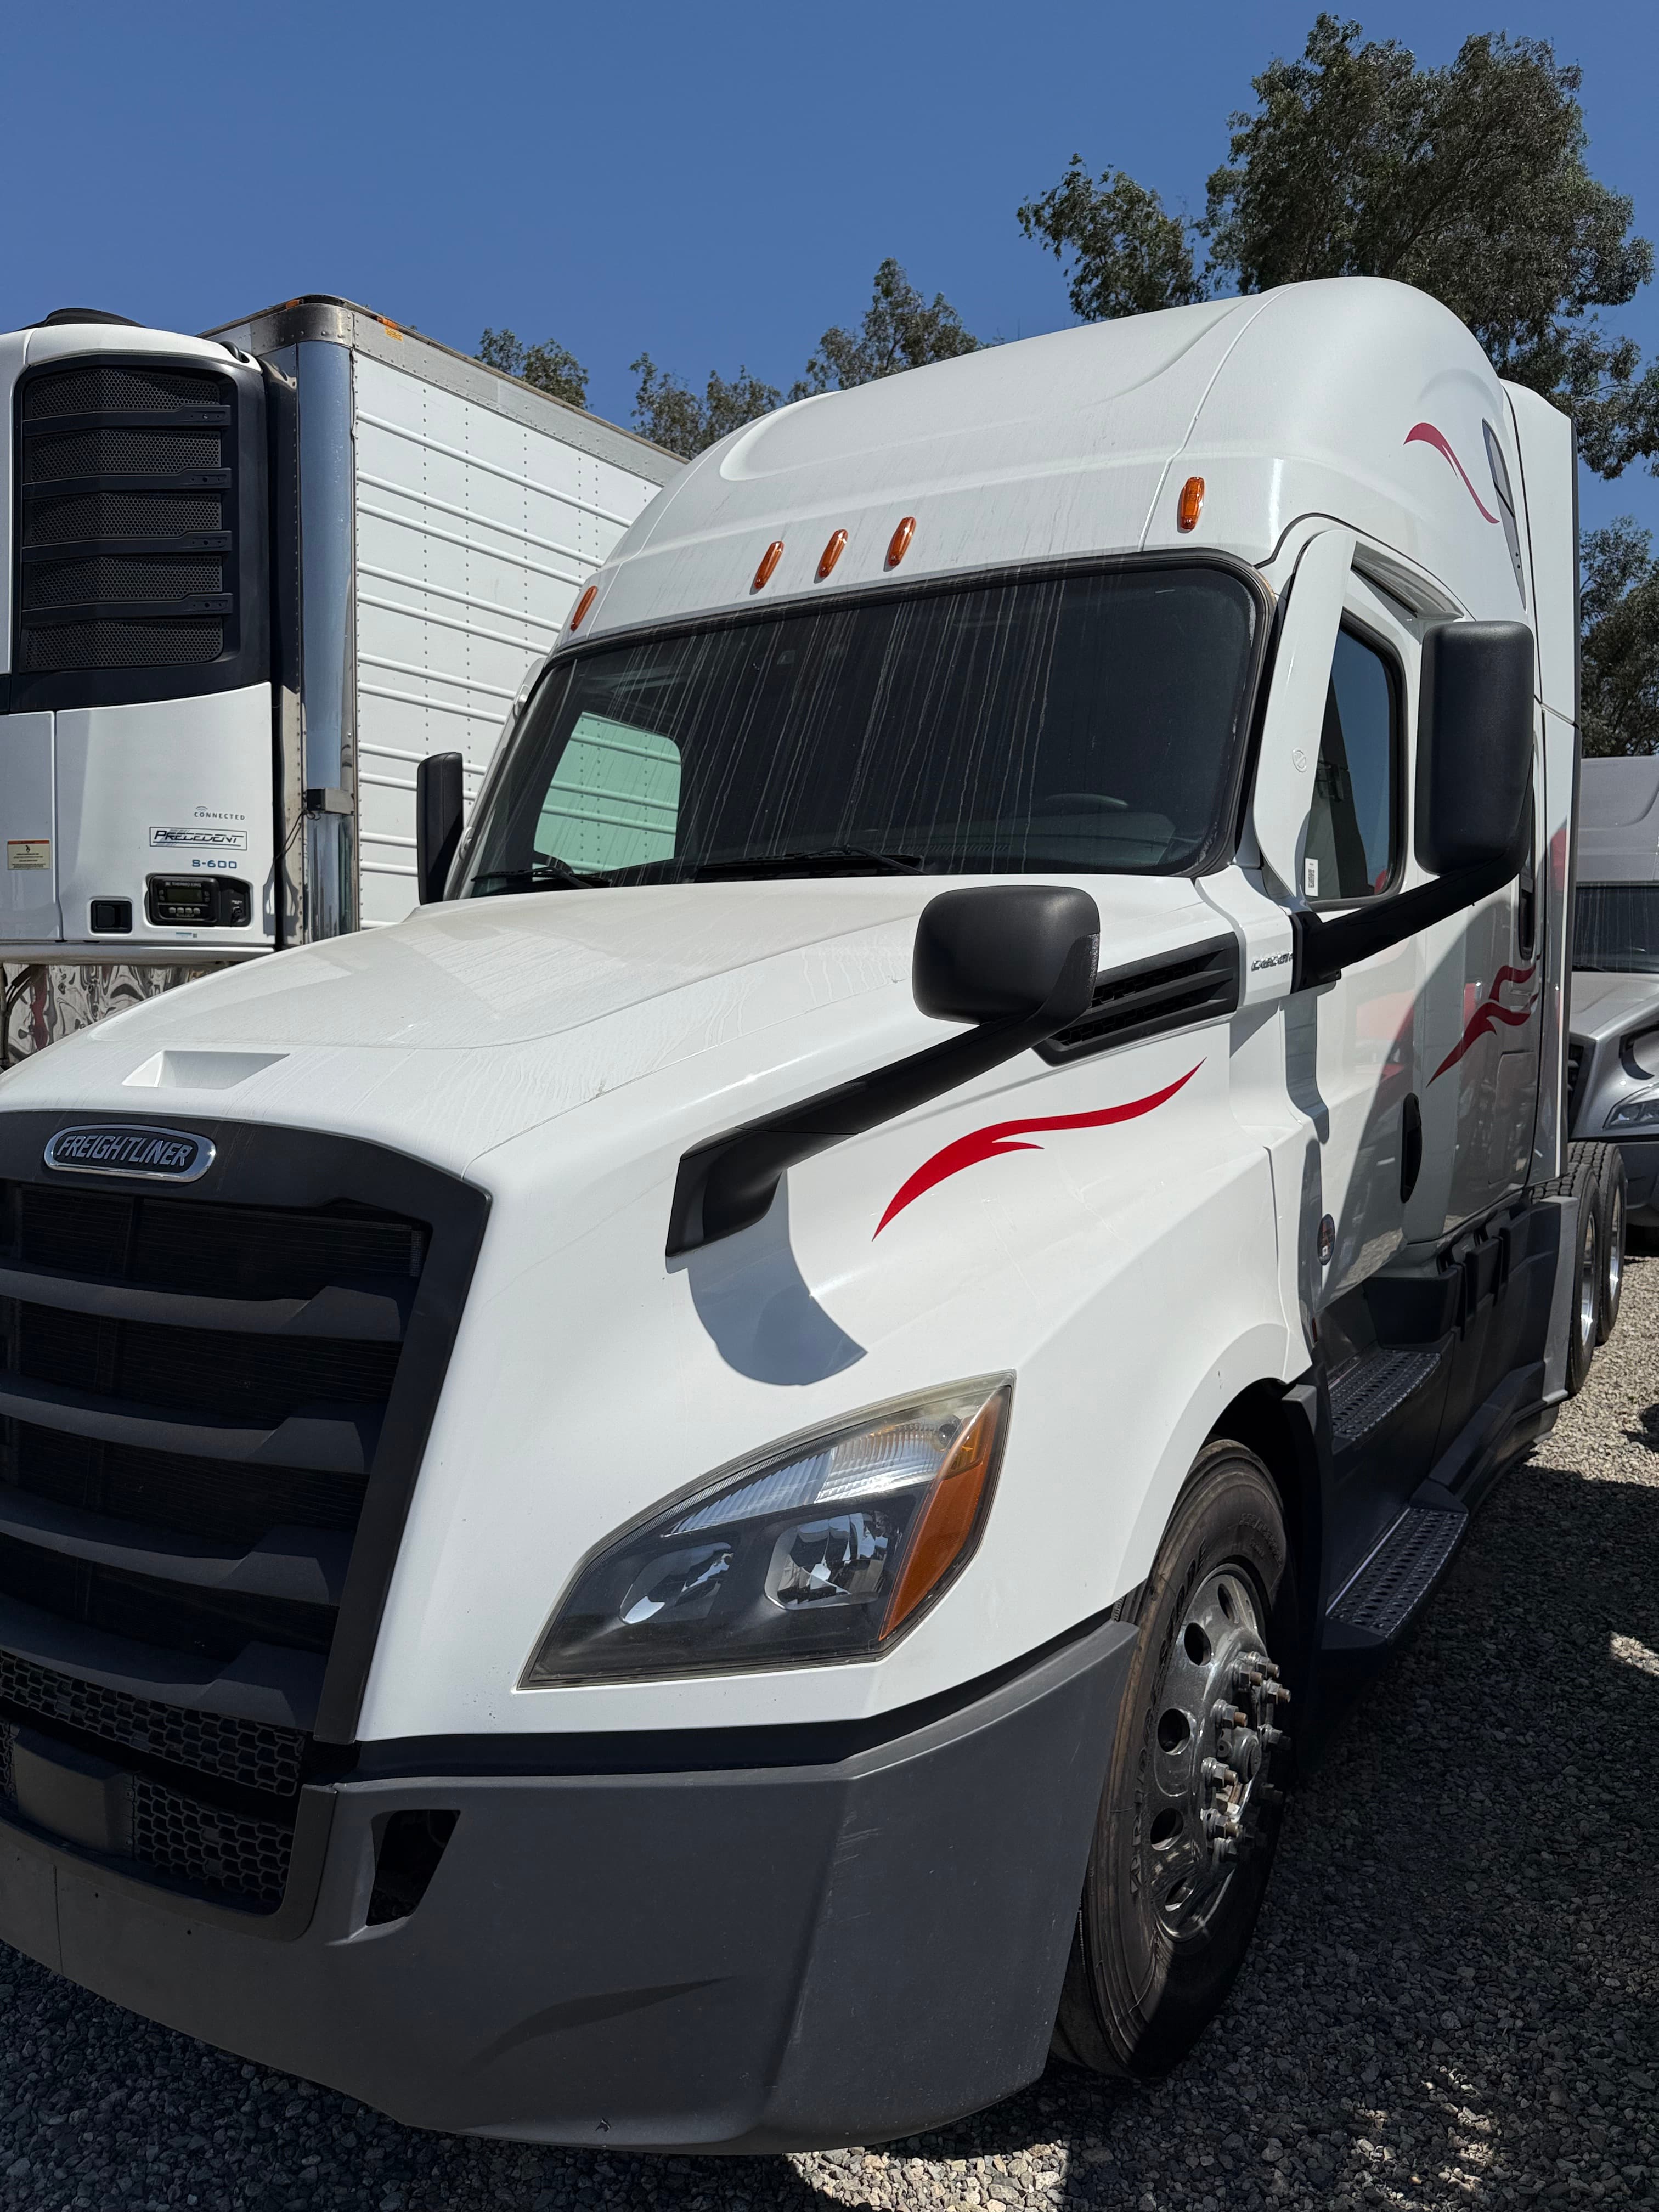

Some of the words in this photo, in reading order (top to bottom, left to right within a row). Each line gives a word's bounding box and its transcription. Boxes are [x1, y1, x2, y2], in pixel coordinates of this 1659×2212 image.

[194, 811, 245, 821] CONNECTED
[154, 830, 244, 843] PRECEDENT
[192, 859, 238, 869] S-600
[57, 1135, 193, 1167] FREIGHTLINER
